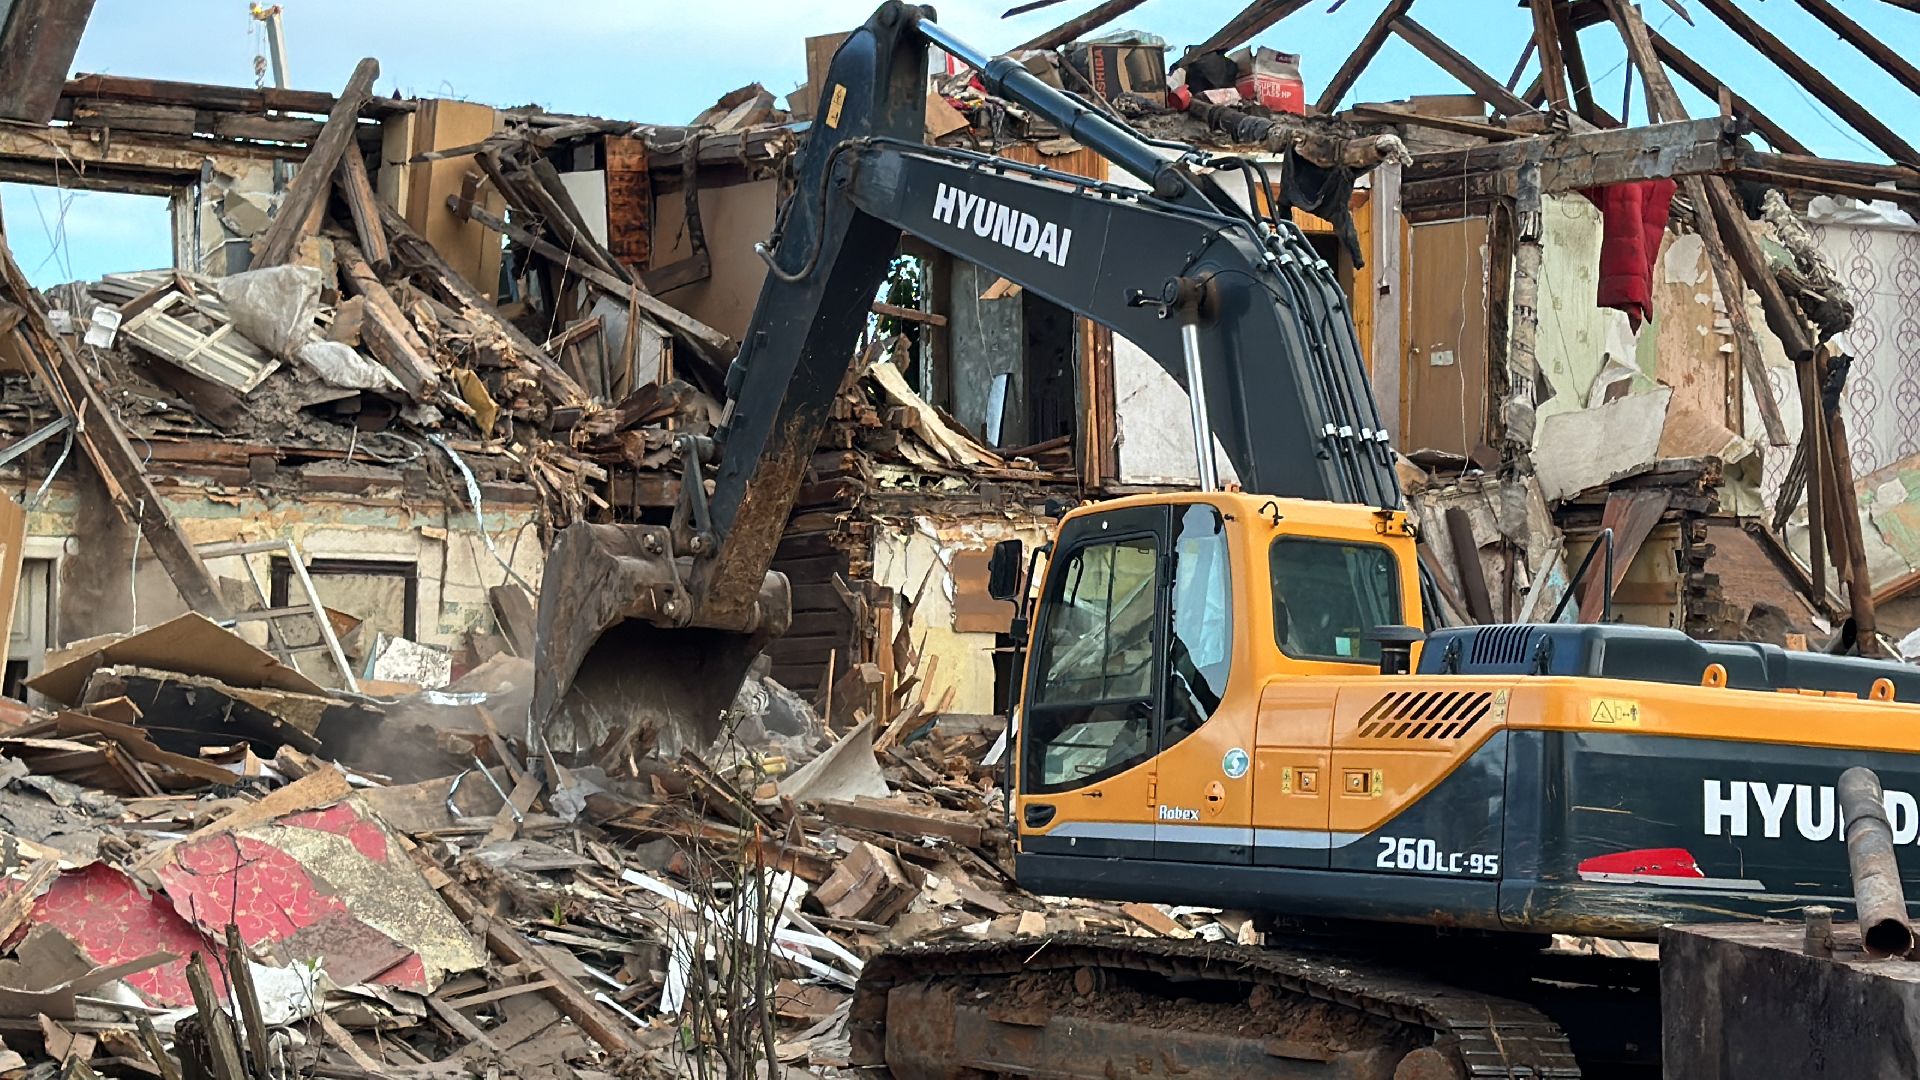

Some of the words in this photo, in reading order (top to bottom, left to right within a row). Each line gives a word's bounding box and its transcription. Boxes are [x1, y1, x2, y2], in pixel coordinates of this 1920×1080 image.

[1094, 48, 1107, 101] OSHIBA
[932, 182, 1073, 268] HYUNDAI
[1159, 804, 1200, 821] Robex
[1703, 779, 1920, 847] HYUD
